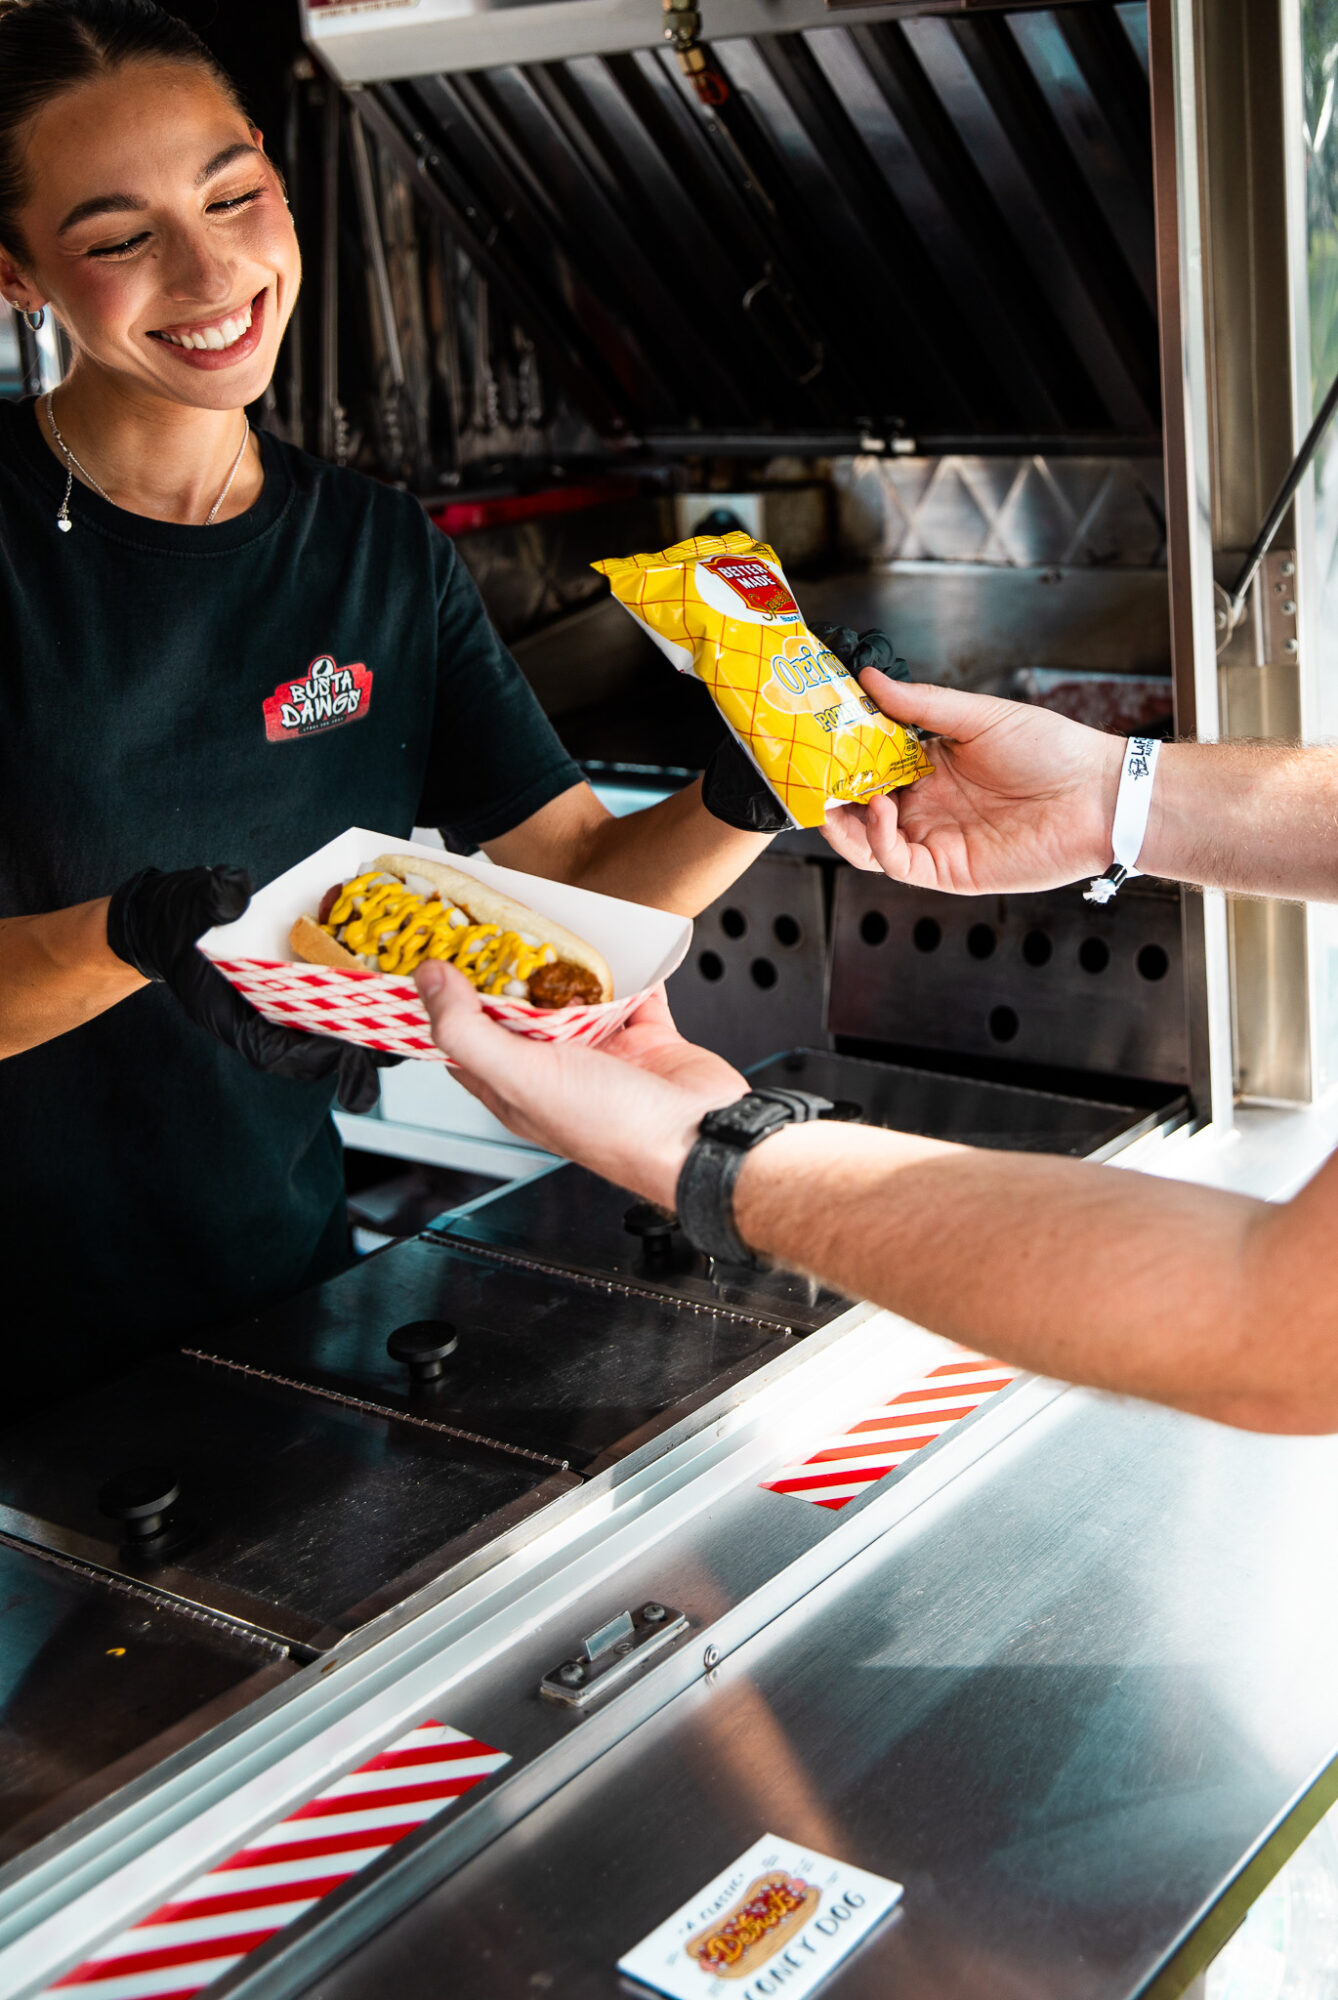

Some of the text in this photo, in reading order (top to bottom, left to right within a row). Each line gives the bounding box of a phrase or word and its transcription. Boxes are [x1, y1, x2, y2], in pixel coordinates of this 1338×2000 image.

[717, 564, 769, 579] BETTER
[736, 575, 777, 590] MADE
[289, 670, 353, 704] BUSTA
[281, 689, 361, 728] DAWGS
[814, 1889, 866, 1936] DOG
